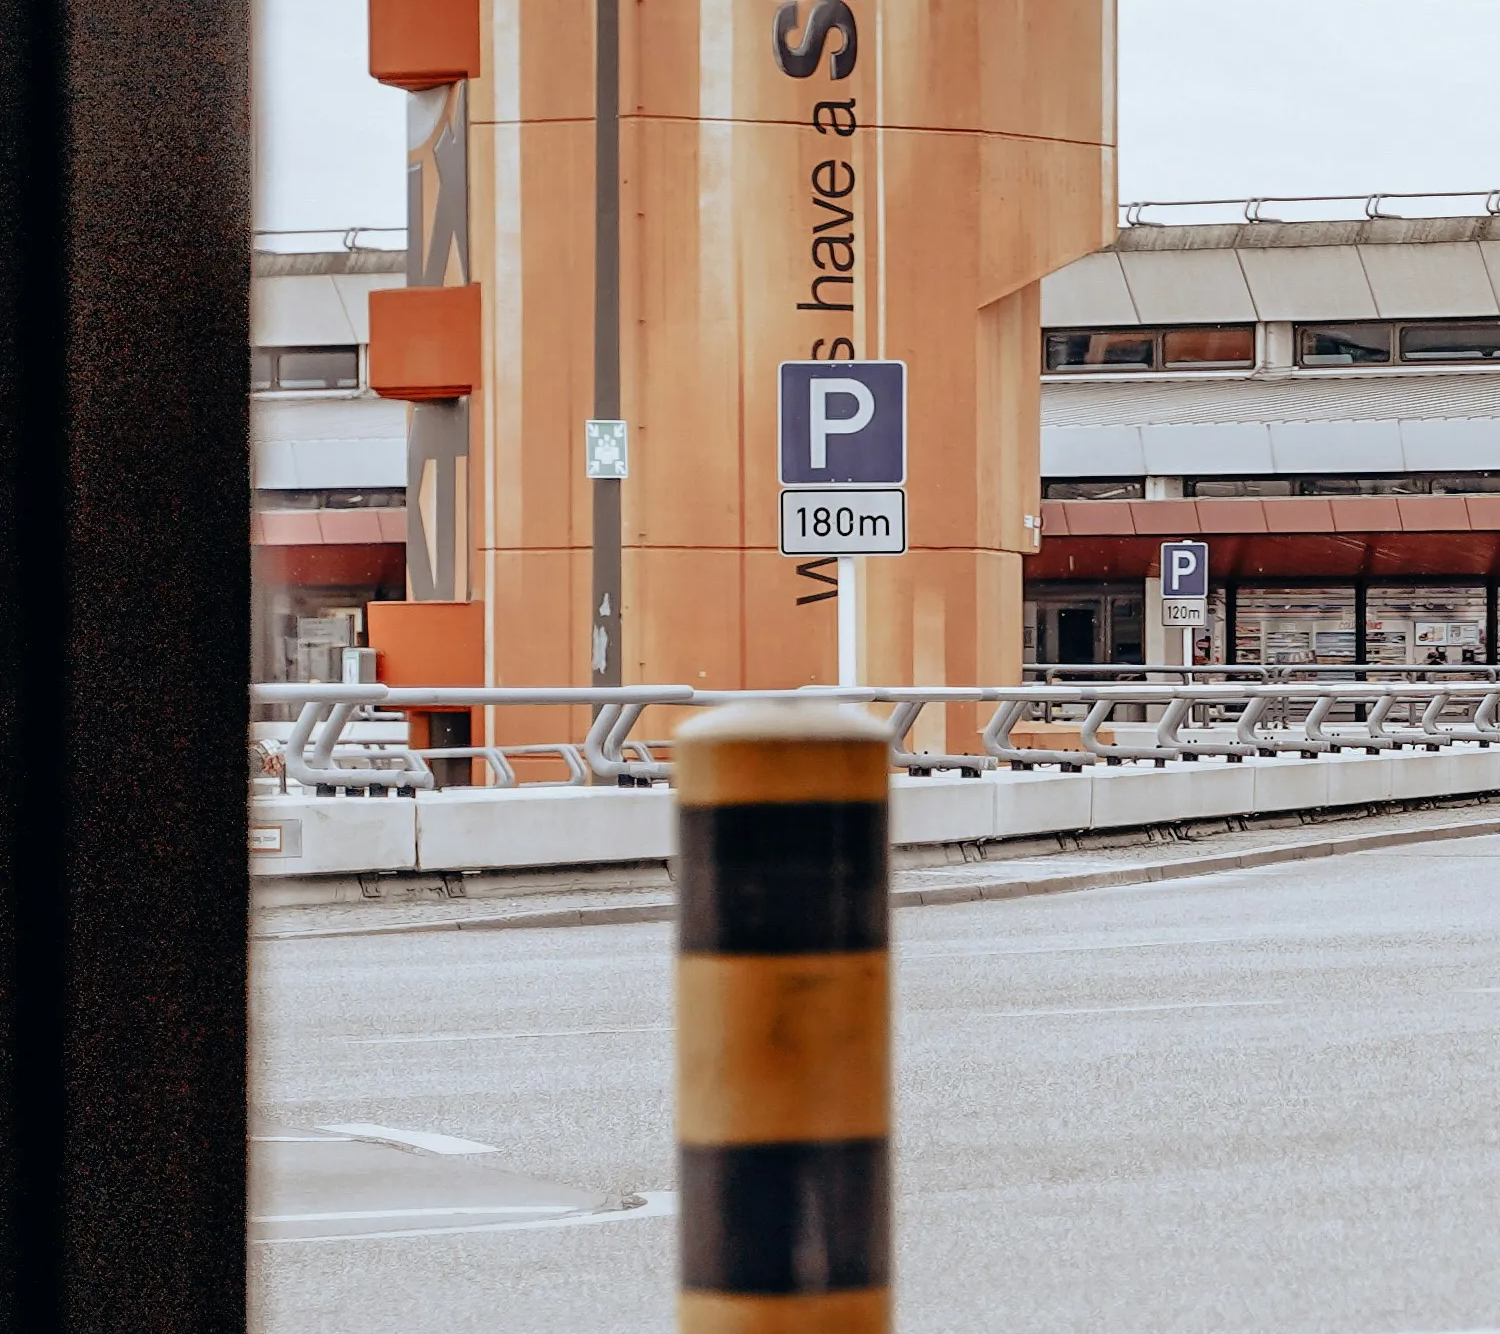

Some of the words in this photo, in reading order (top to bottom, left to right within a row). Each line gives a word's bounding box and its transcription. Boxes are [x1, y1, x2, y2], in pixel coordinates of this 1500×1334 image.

[812, 97, 857, 138] a
[796, 159, 855, 310] have
[809, 377, 875, 469] P
[796, 506, 890, 538] 180m
[1172, 550, 1197, 591] P
[1168, 606, 1200, 620] 120m
